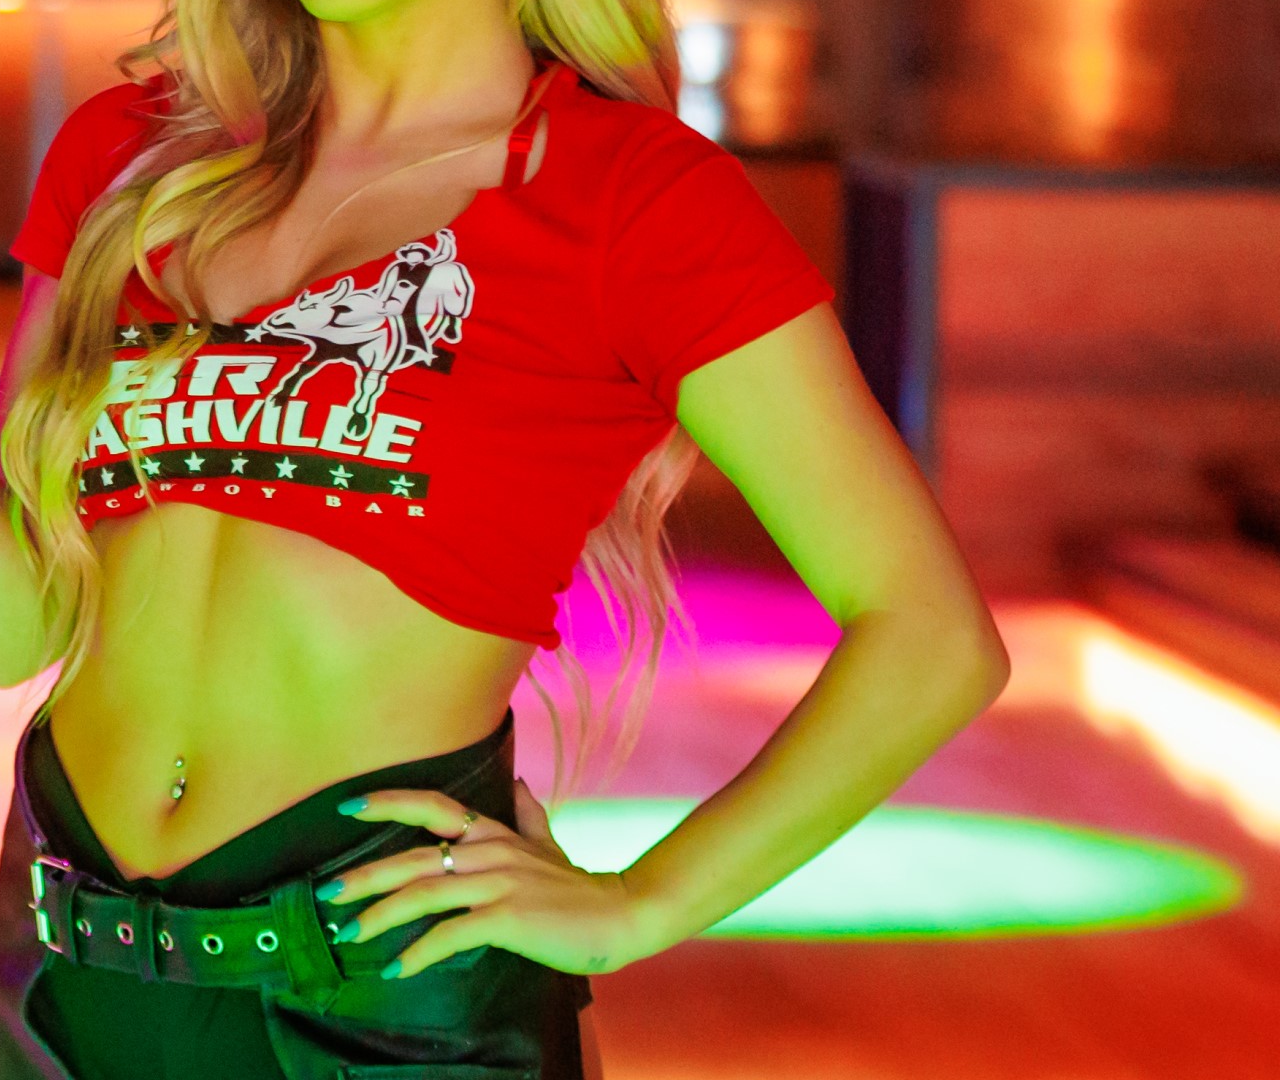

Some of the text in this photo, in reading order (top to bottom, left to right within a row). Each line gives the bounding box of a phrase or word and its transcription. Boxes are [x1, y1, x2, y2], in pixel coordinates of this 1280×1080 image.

[108, 355, 277, 404] BR
[80, 398, 422, 464] ASHVILLE
[326, 495, 426, 517] BAR
